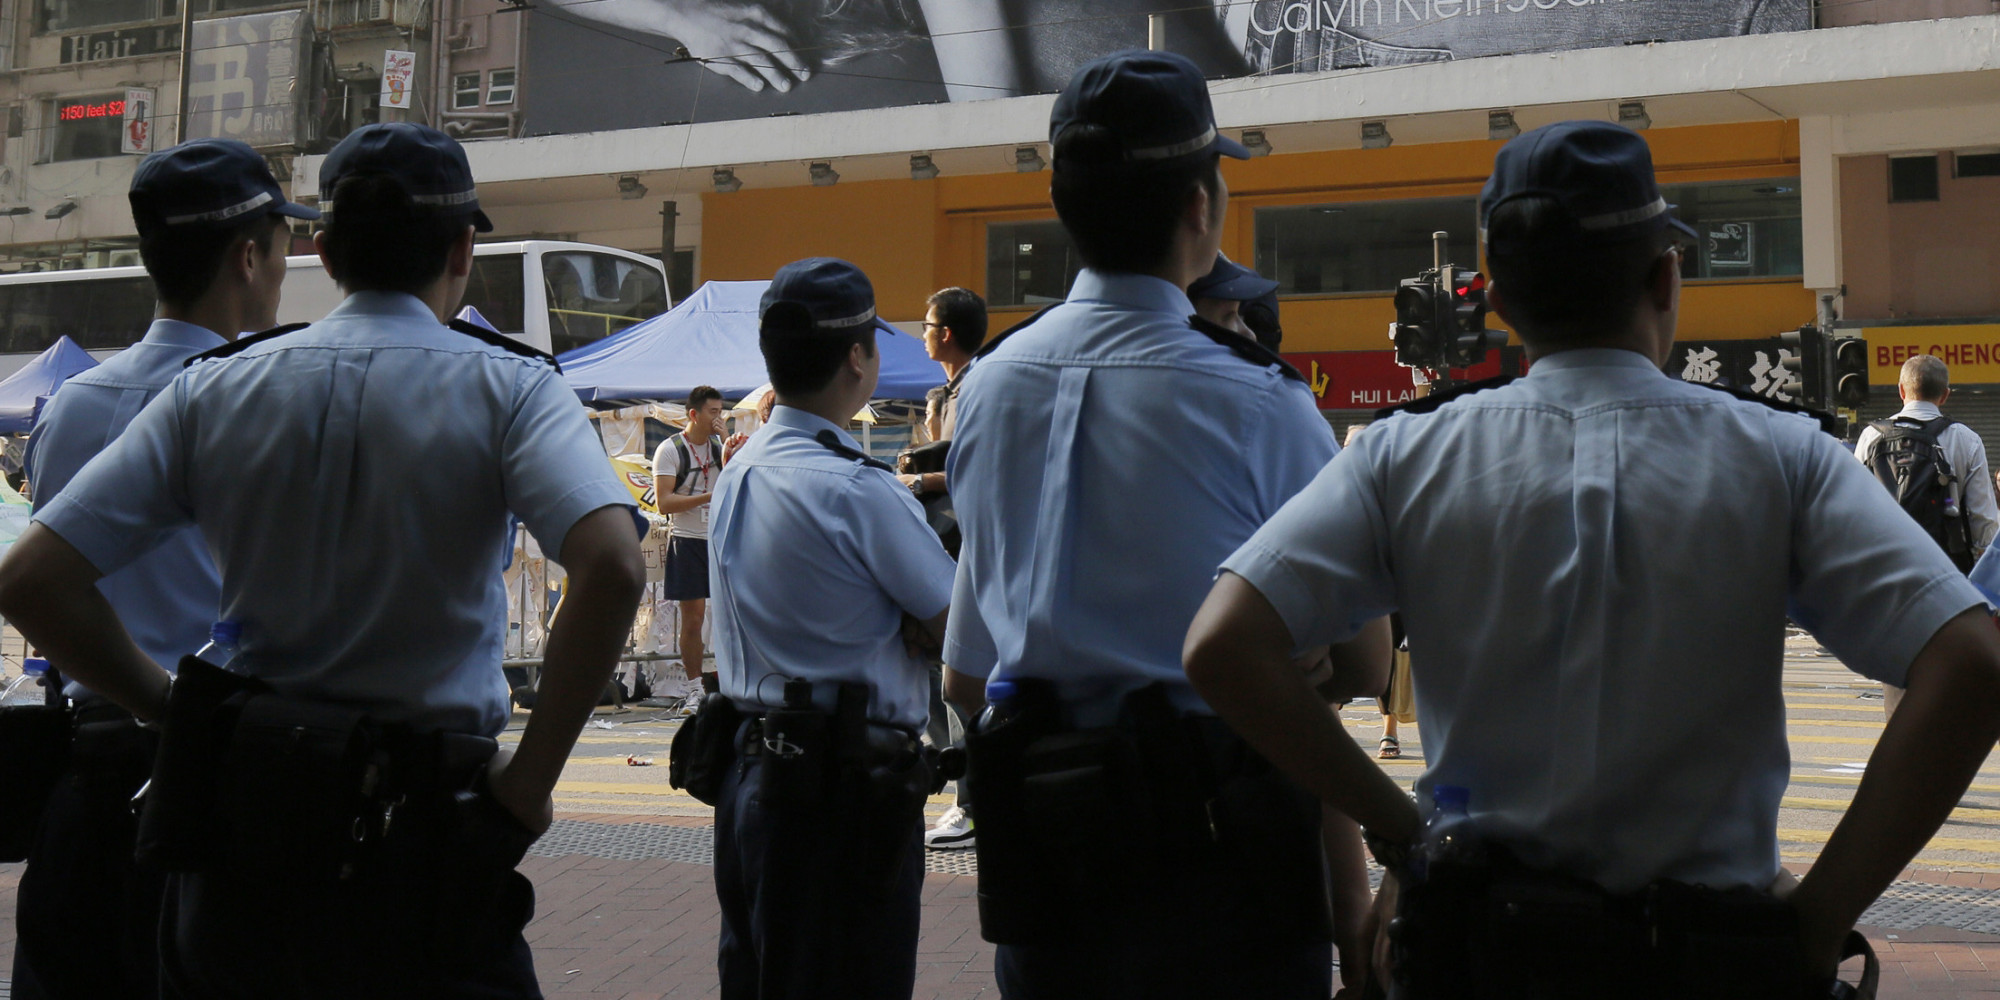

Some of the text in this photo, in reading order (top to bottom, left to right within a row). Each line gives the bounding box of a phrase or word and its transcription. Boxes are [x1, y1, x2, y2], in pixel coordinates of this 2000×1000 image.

[70, 30, 137, 62] Hair
[86, 103, 108, 118] feet
[1351, 389, 1381, 404] HUI
